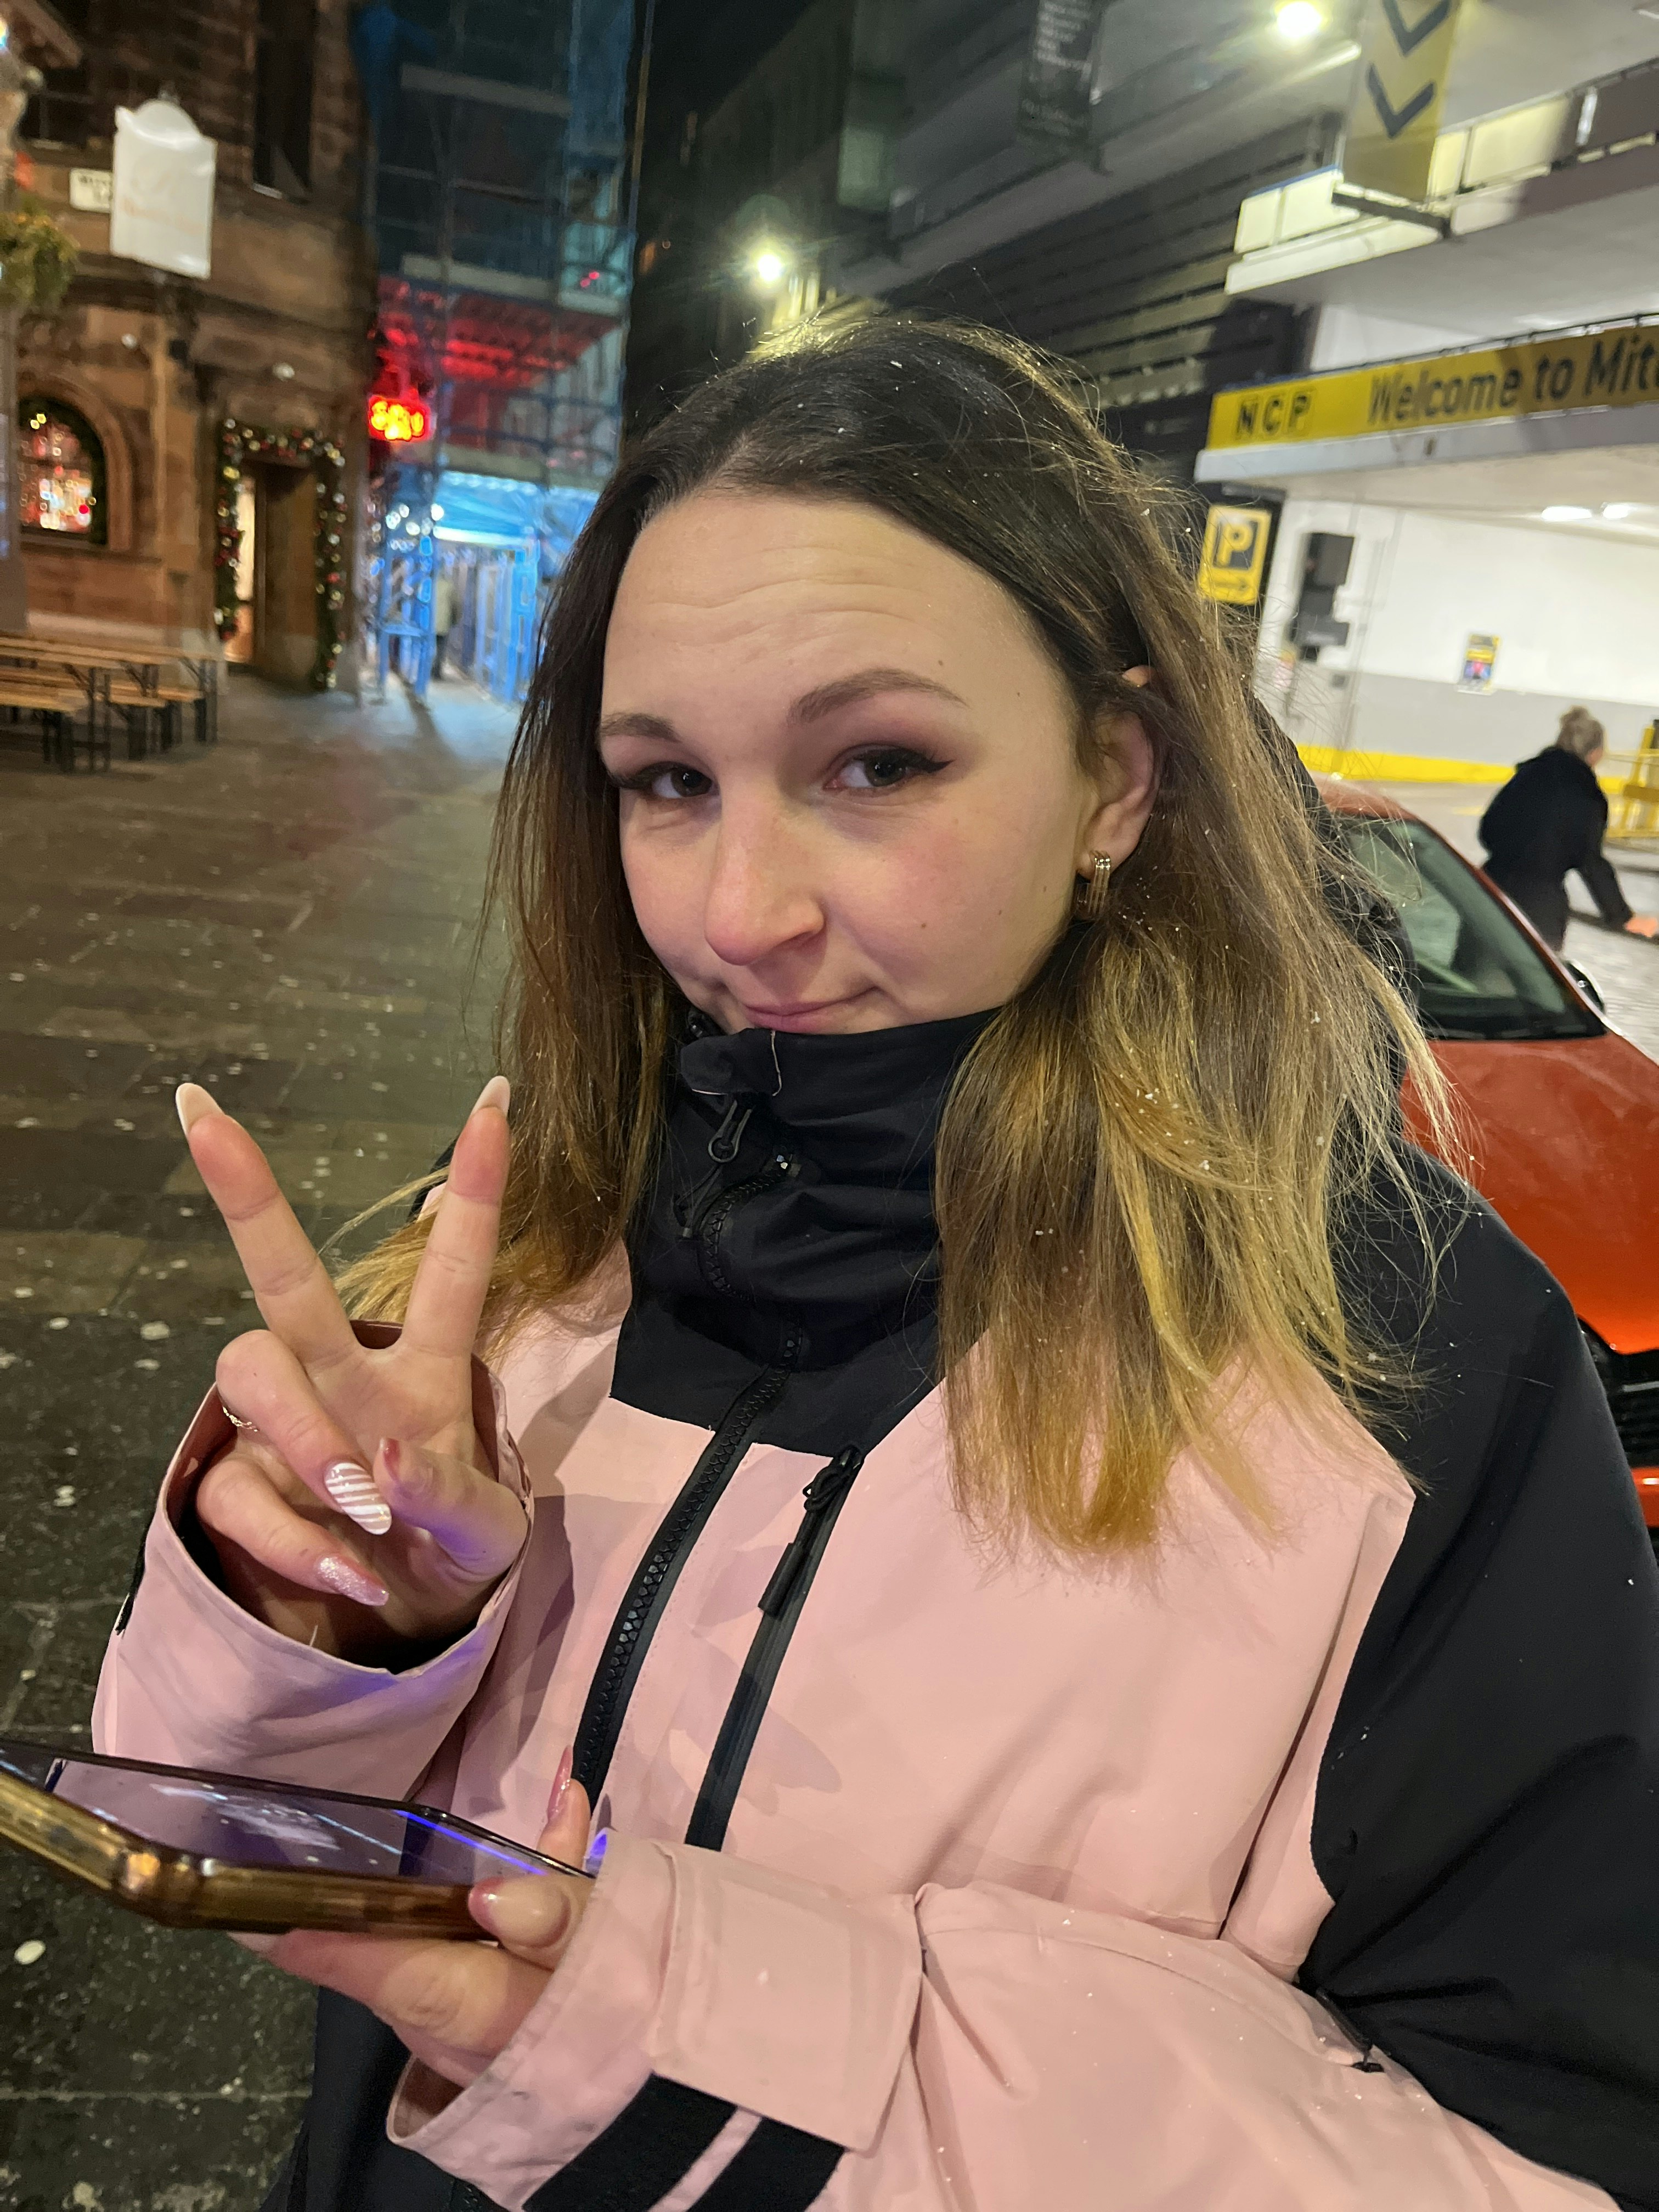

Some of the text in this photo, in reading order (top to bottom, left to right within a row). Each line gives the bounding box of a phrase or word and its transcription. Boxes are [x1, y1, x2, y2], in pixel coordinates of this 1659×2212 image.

[1368, 334, 1659, 424] Welcome to Mit
[1236, 391, 1312, 436] NCP
[1217, 522, 1254, 566] P
